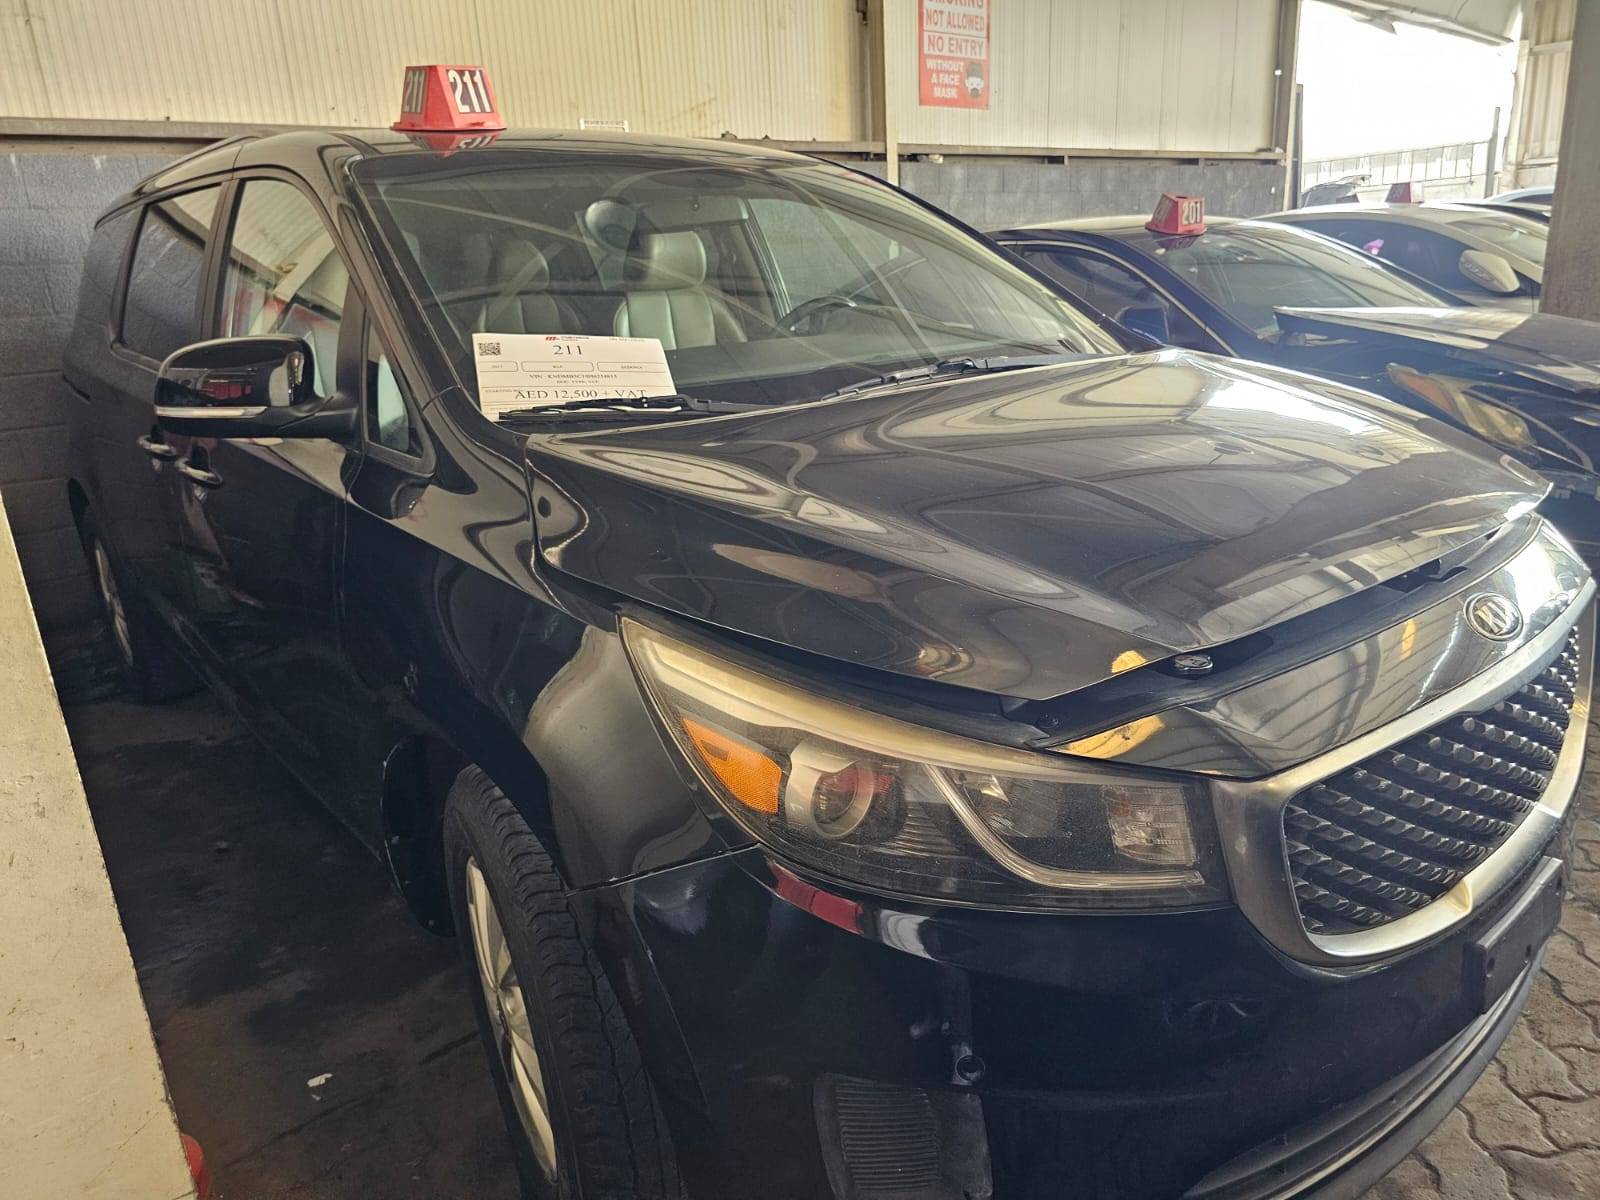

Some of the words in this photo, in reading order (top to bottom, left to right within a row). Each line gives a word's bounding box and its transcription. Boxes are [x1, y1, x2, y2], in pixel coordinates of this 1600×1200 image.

[926, 8, 944, 27] NOT
[946, 10, 985, 32] ALLOWED
[927, 34, 944, 52] NO
[948, 37, 984, 56] ENTRY
[926, 58, 964, 73] WITHOUT
[939, 73, 961, 86] FACE
[402, 69, 425, 113] 211
[447, 69, 492, 113] 211
[1182, 201, 1201, 225] 201
[552, 344, 582, 355] 211
[515, 390, 549, 399] AED
[554, 389, 598, 399] 12,500
[615, 390, 646, 398] VAT
